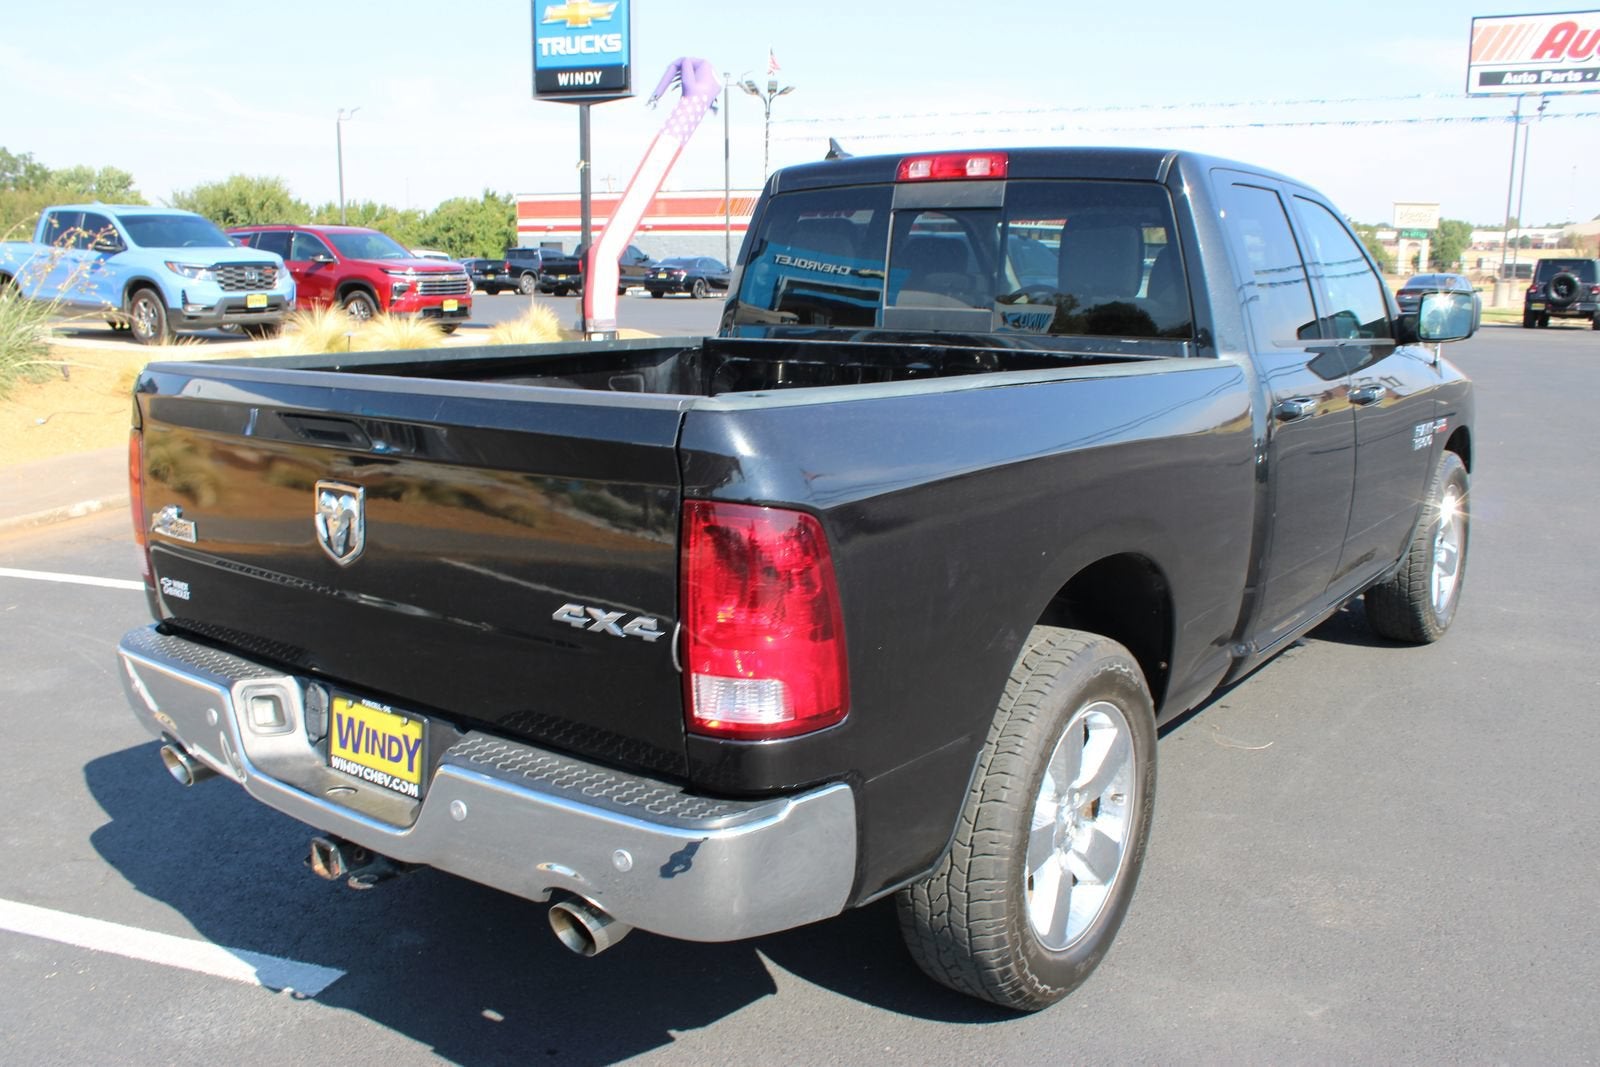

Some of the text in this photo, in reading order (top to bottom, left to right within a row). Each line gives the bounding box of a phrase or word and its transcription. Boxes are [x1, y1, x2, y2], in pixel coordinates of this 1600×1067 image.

[538, 33, 622, 56] TRUCKS
[1530, 21, 1600, 60] Au
[557, 71, 602, 87] WINDY
[1501, 70, 1583, 85] Auto Parts
[336, 712, 422, 774] WINDY
[331, 755, 419, 798] WINDYCHEV.COM
